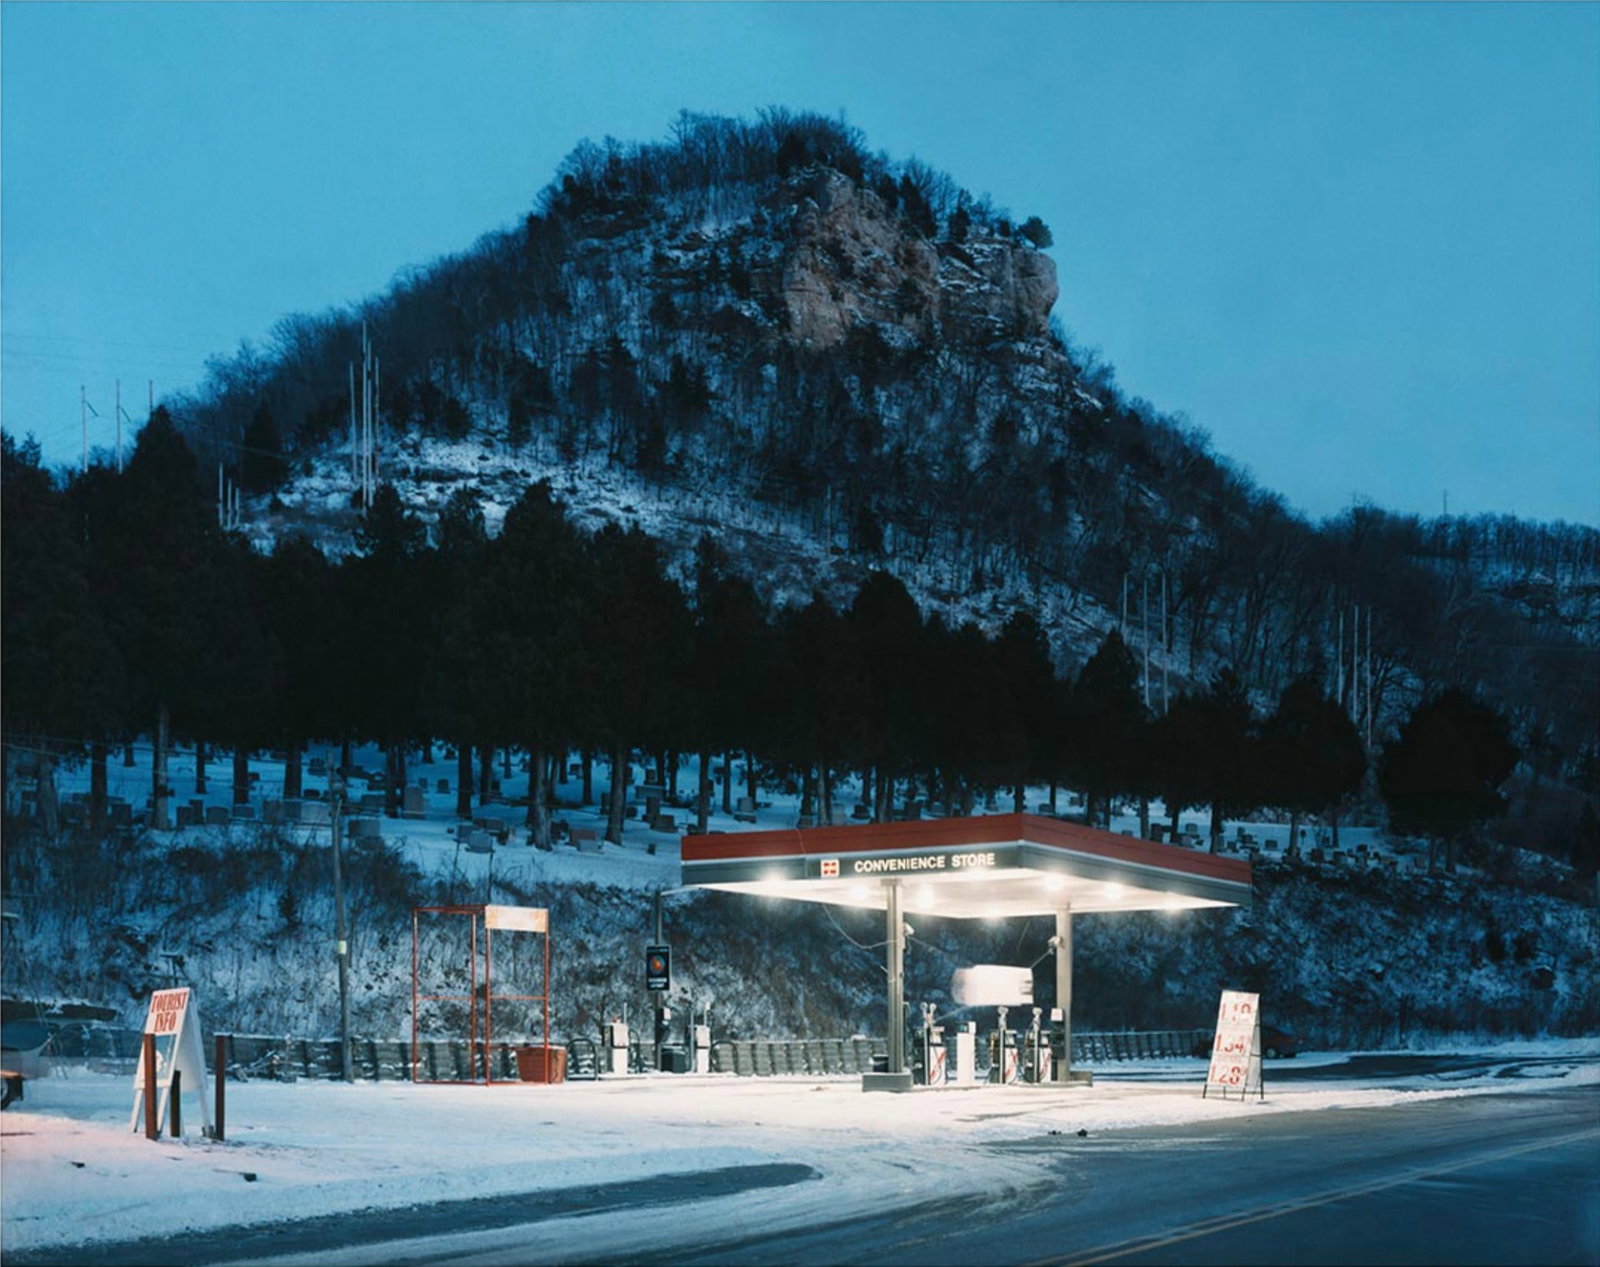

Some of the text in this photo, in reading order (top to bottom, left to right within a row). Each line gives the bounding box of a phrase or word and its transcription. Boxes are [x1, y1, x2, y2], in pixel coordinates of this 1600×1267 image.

[854, 852, 996, 873] CONVENIENCE STORE
[151, 992, 187, 1013] TOURIST
[153, 1011, 177, 1032] INFO
